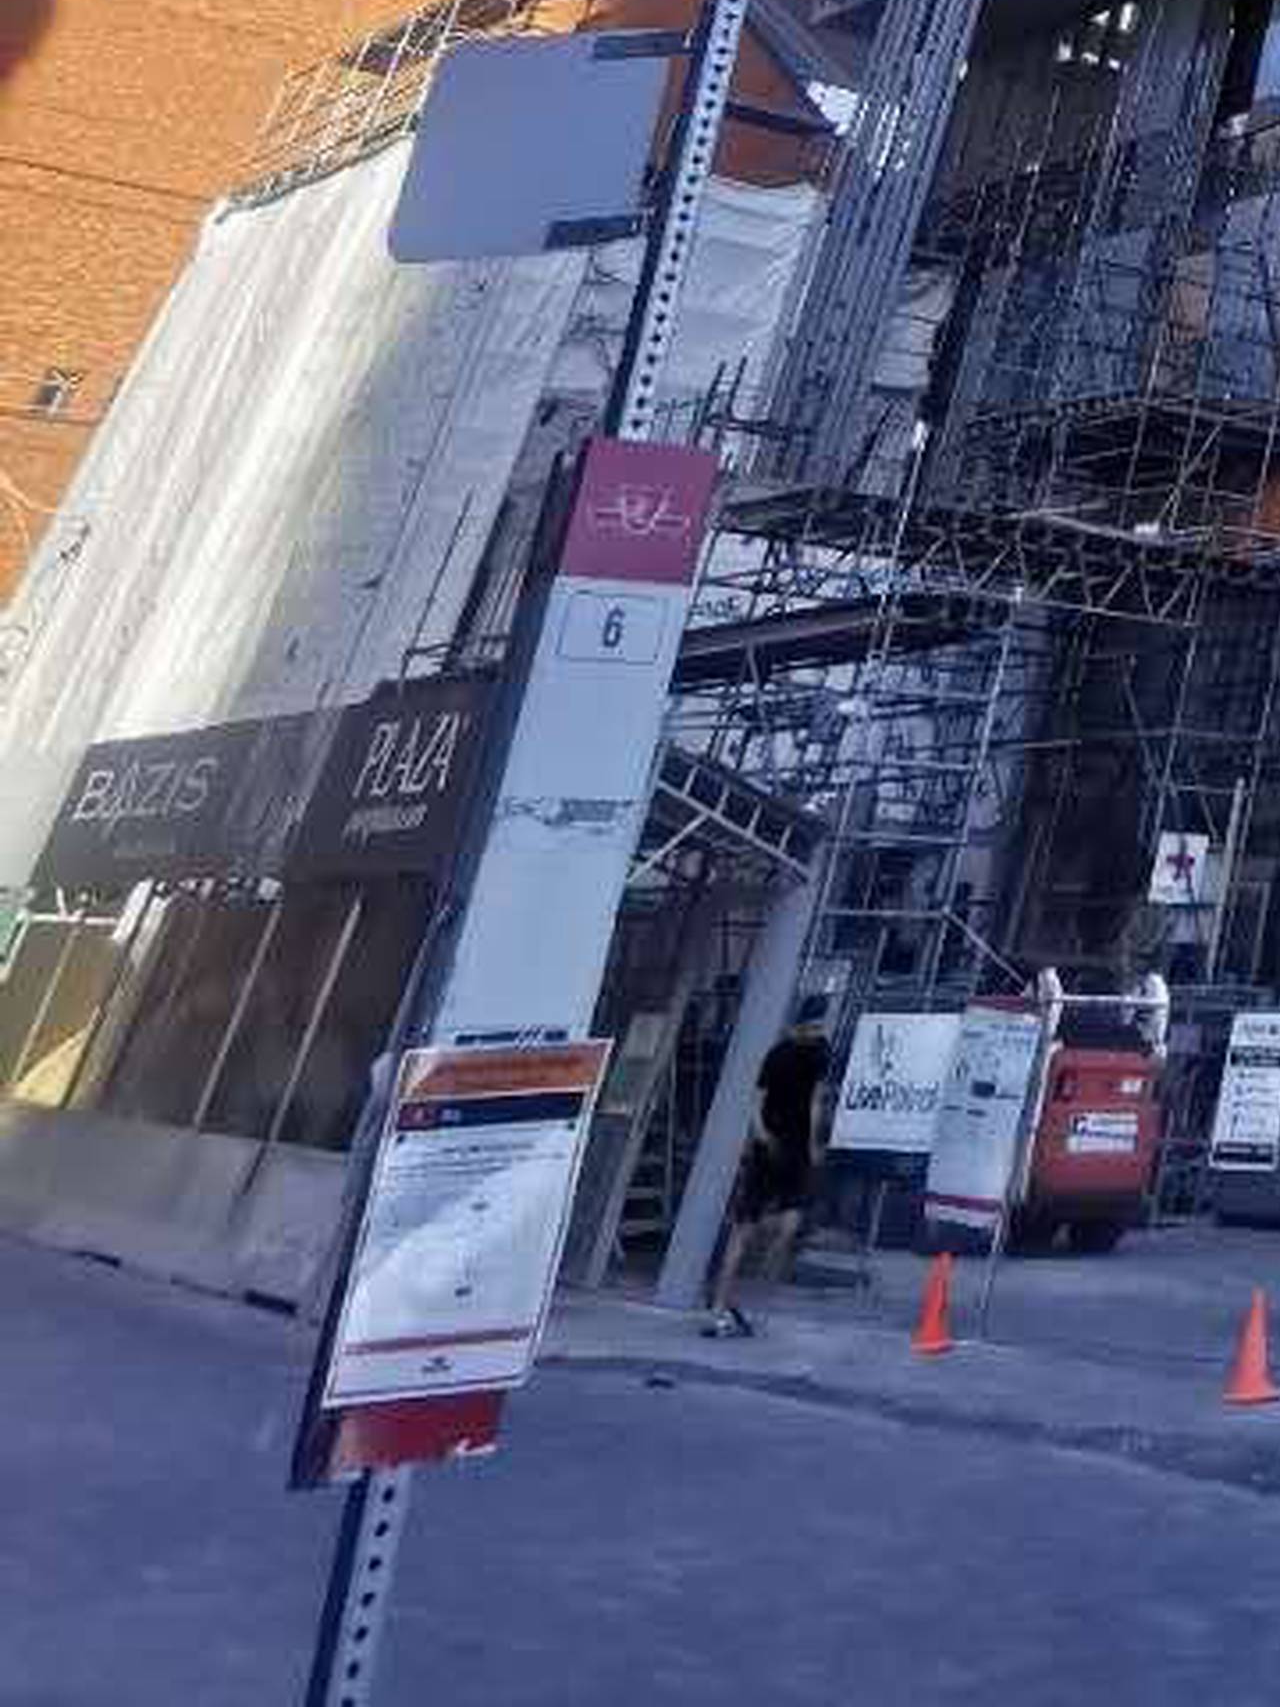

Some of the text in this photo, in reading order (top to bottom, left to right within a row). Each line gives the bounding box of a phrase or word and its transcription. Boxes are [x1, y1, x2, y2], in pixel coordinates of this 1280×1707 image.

[602, 606, 626, 648] 6
[352, 710, 461, 799] PLAZA
[72, 757, 218, 824] BAZIS
